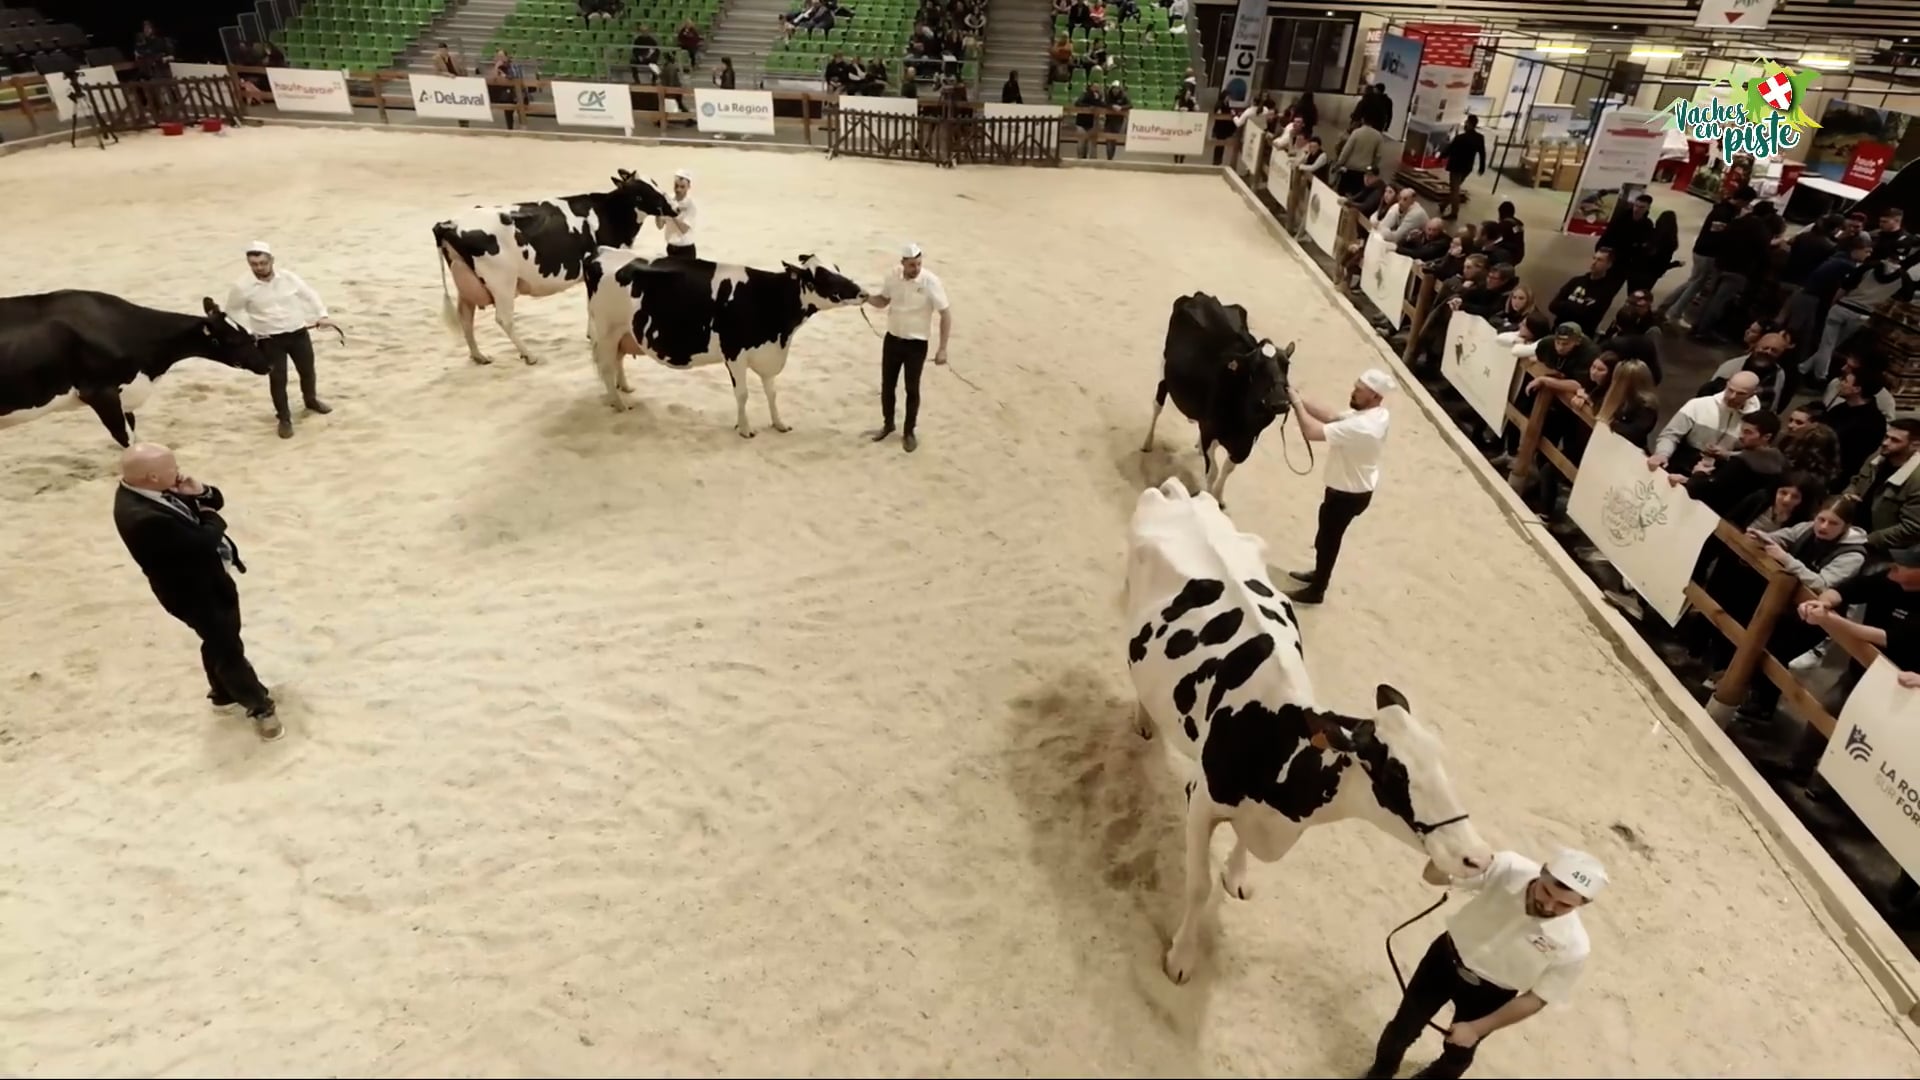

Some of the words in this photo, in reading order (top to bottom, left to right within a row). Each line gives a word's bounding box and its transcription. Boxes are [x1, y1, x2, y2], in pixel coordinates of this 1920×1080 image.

[1229, 43, 1256, 77] ici
[434, 91, 485, 106] DeLaval
[717, 102, 730, 112] La
[1880, 761, 1896, 783] LA
[1875, 773, 1897, 799] SUR
[1571, 870, 1592, 887] 491
